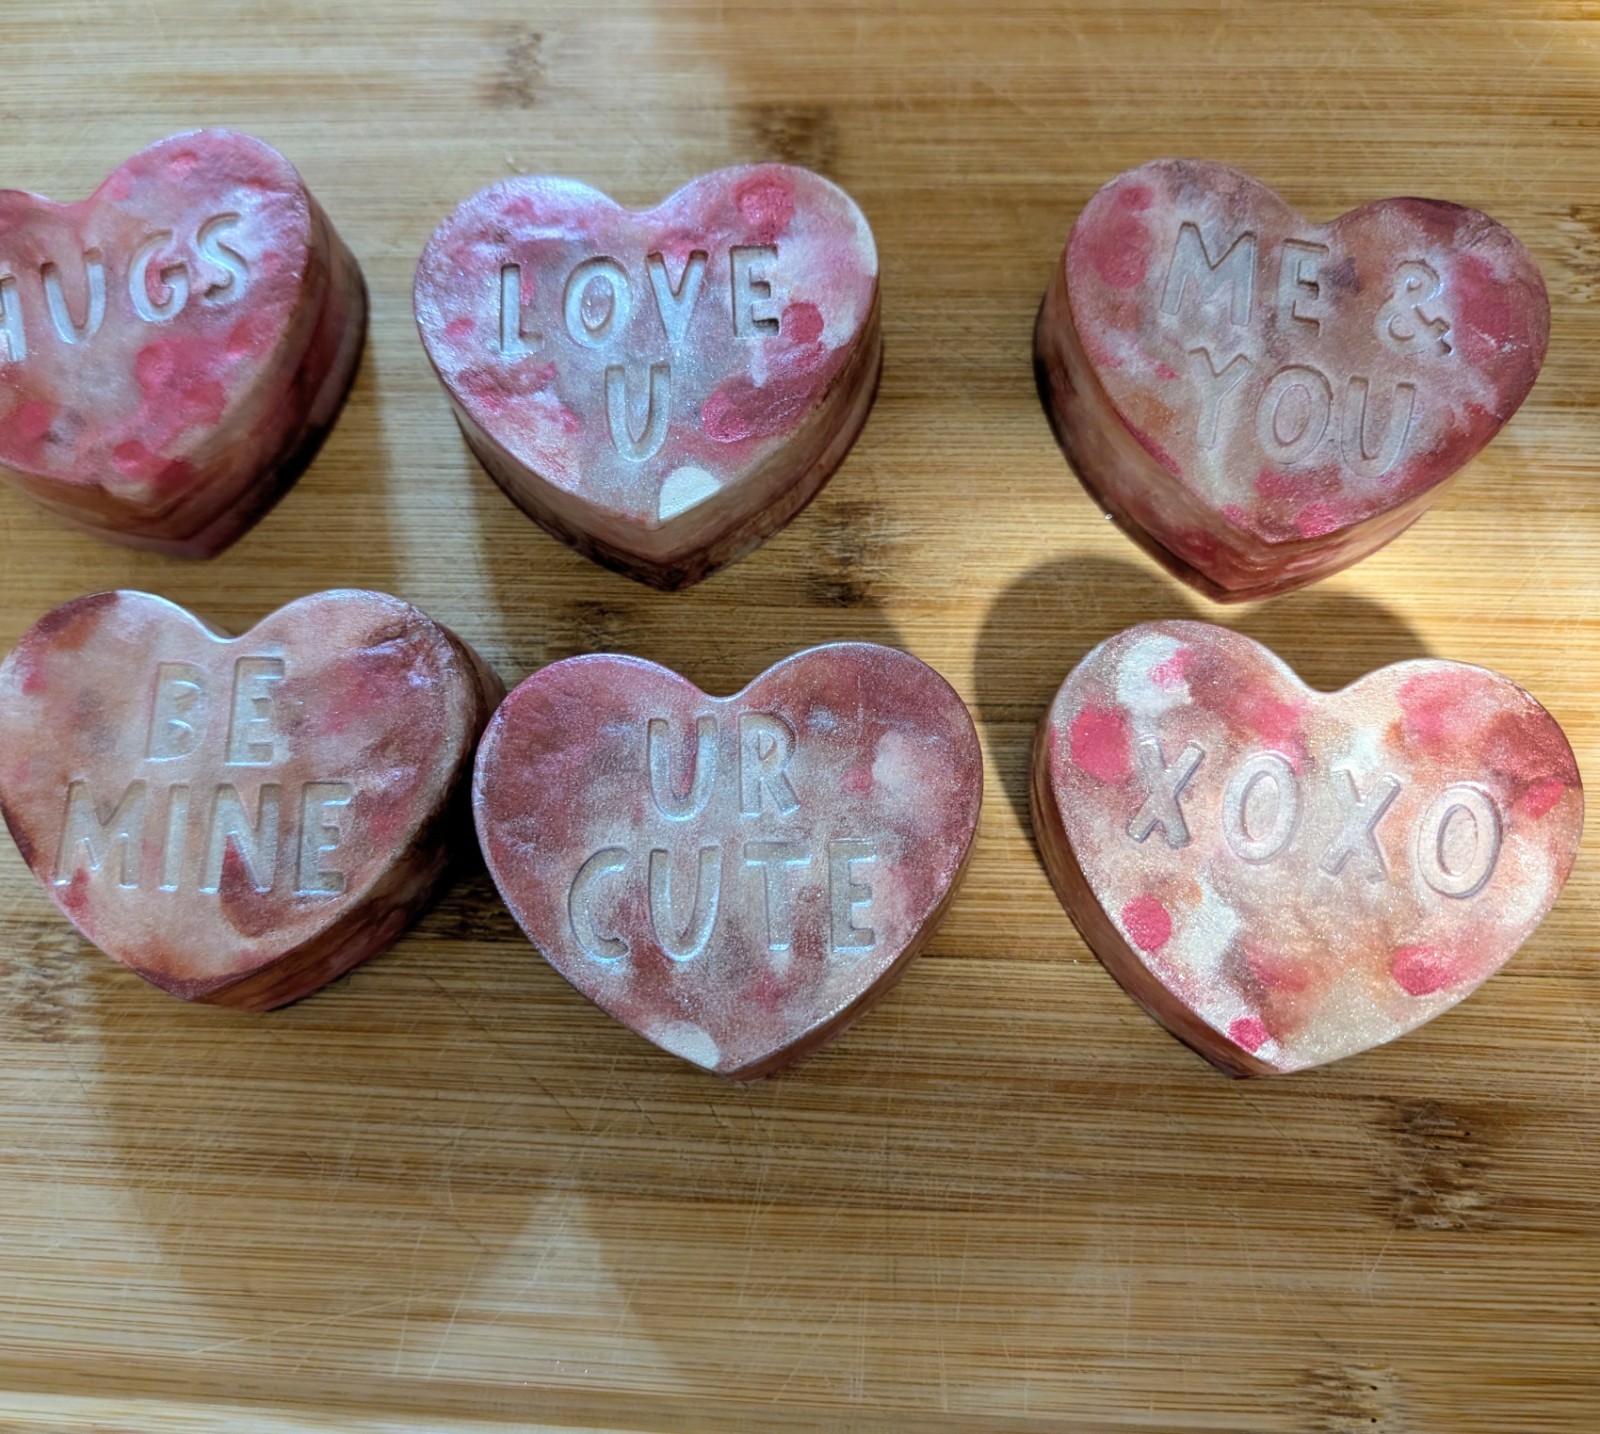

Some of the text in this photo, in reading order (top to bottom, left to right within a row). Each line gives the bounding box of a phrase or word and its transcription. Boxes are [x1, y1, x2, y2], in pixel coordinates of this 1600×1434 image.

[500, 245, 780, 356] LOVE
[1160, 221, 1454, 355] ME &
[605, 363, 670, 463] U
[1188, 347, 1416, 478] YOU
[144, 656, 286, 767] BE
[647, 711, 801, 821] UR
[53, 778, 351, 896] MINE
[1126, 733, 1503, 899] XOXO
[567, 838, 878, 962] CUTE
